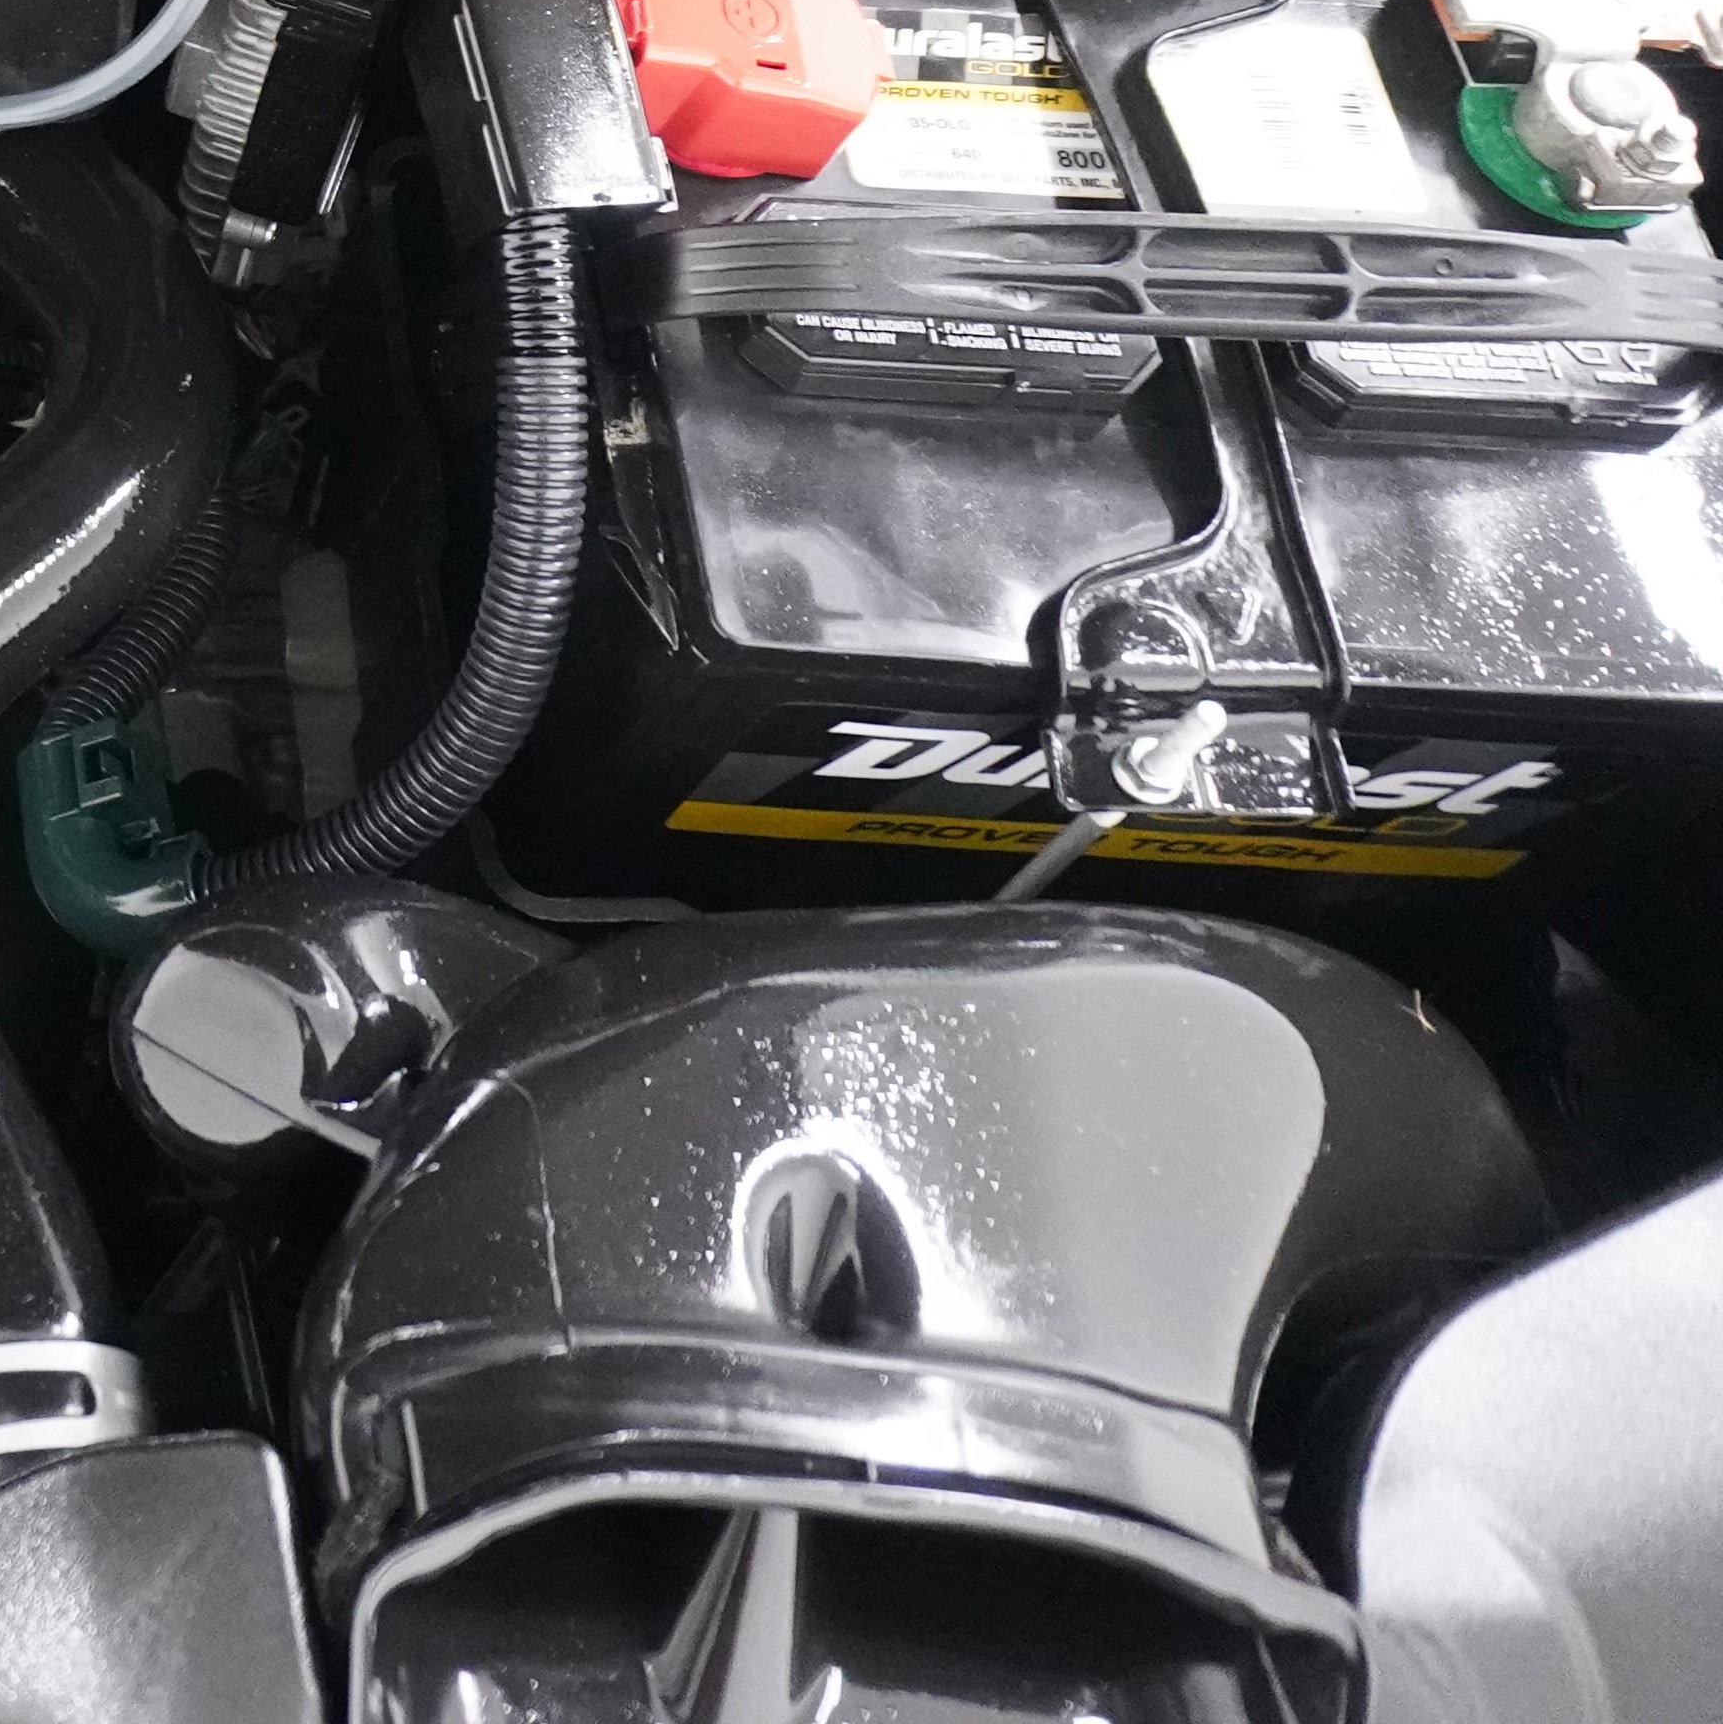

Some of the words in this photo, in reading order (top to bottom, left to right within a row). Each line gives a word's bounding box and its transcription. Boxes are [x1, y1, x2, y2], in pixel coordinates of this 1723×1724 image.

[883, 22, 1062, 62] uralas
[982, 90, 1061, 105] TOUGH
[1057, 150, 1105, 169] 800
[796, 313, 820, 327] CAN
[821, 315, 860, 329] CAUSE
[861, 318, 926, 334] BLINDNESS
[833, 329, 852, 342] OR
[854, 331, 897, 345] INJURY
[1025, 338, 1077, 354] SEVERE
[847, 821, 1110, 847] PROVE
[1131, 838, 1351, 862] TOUGH
